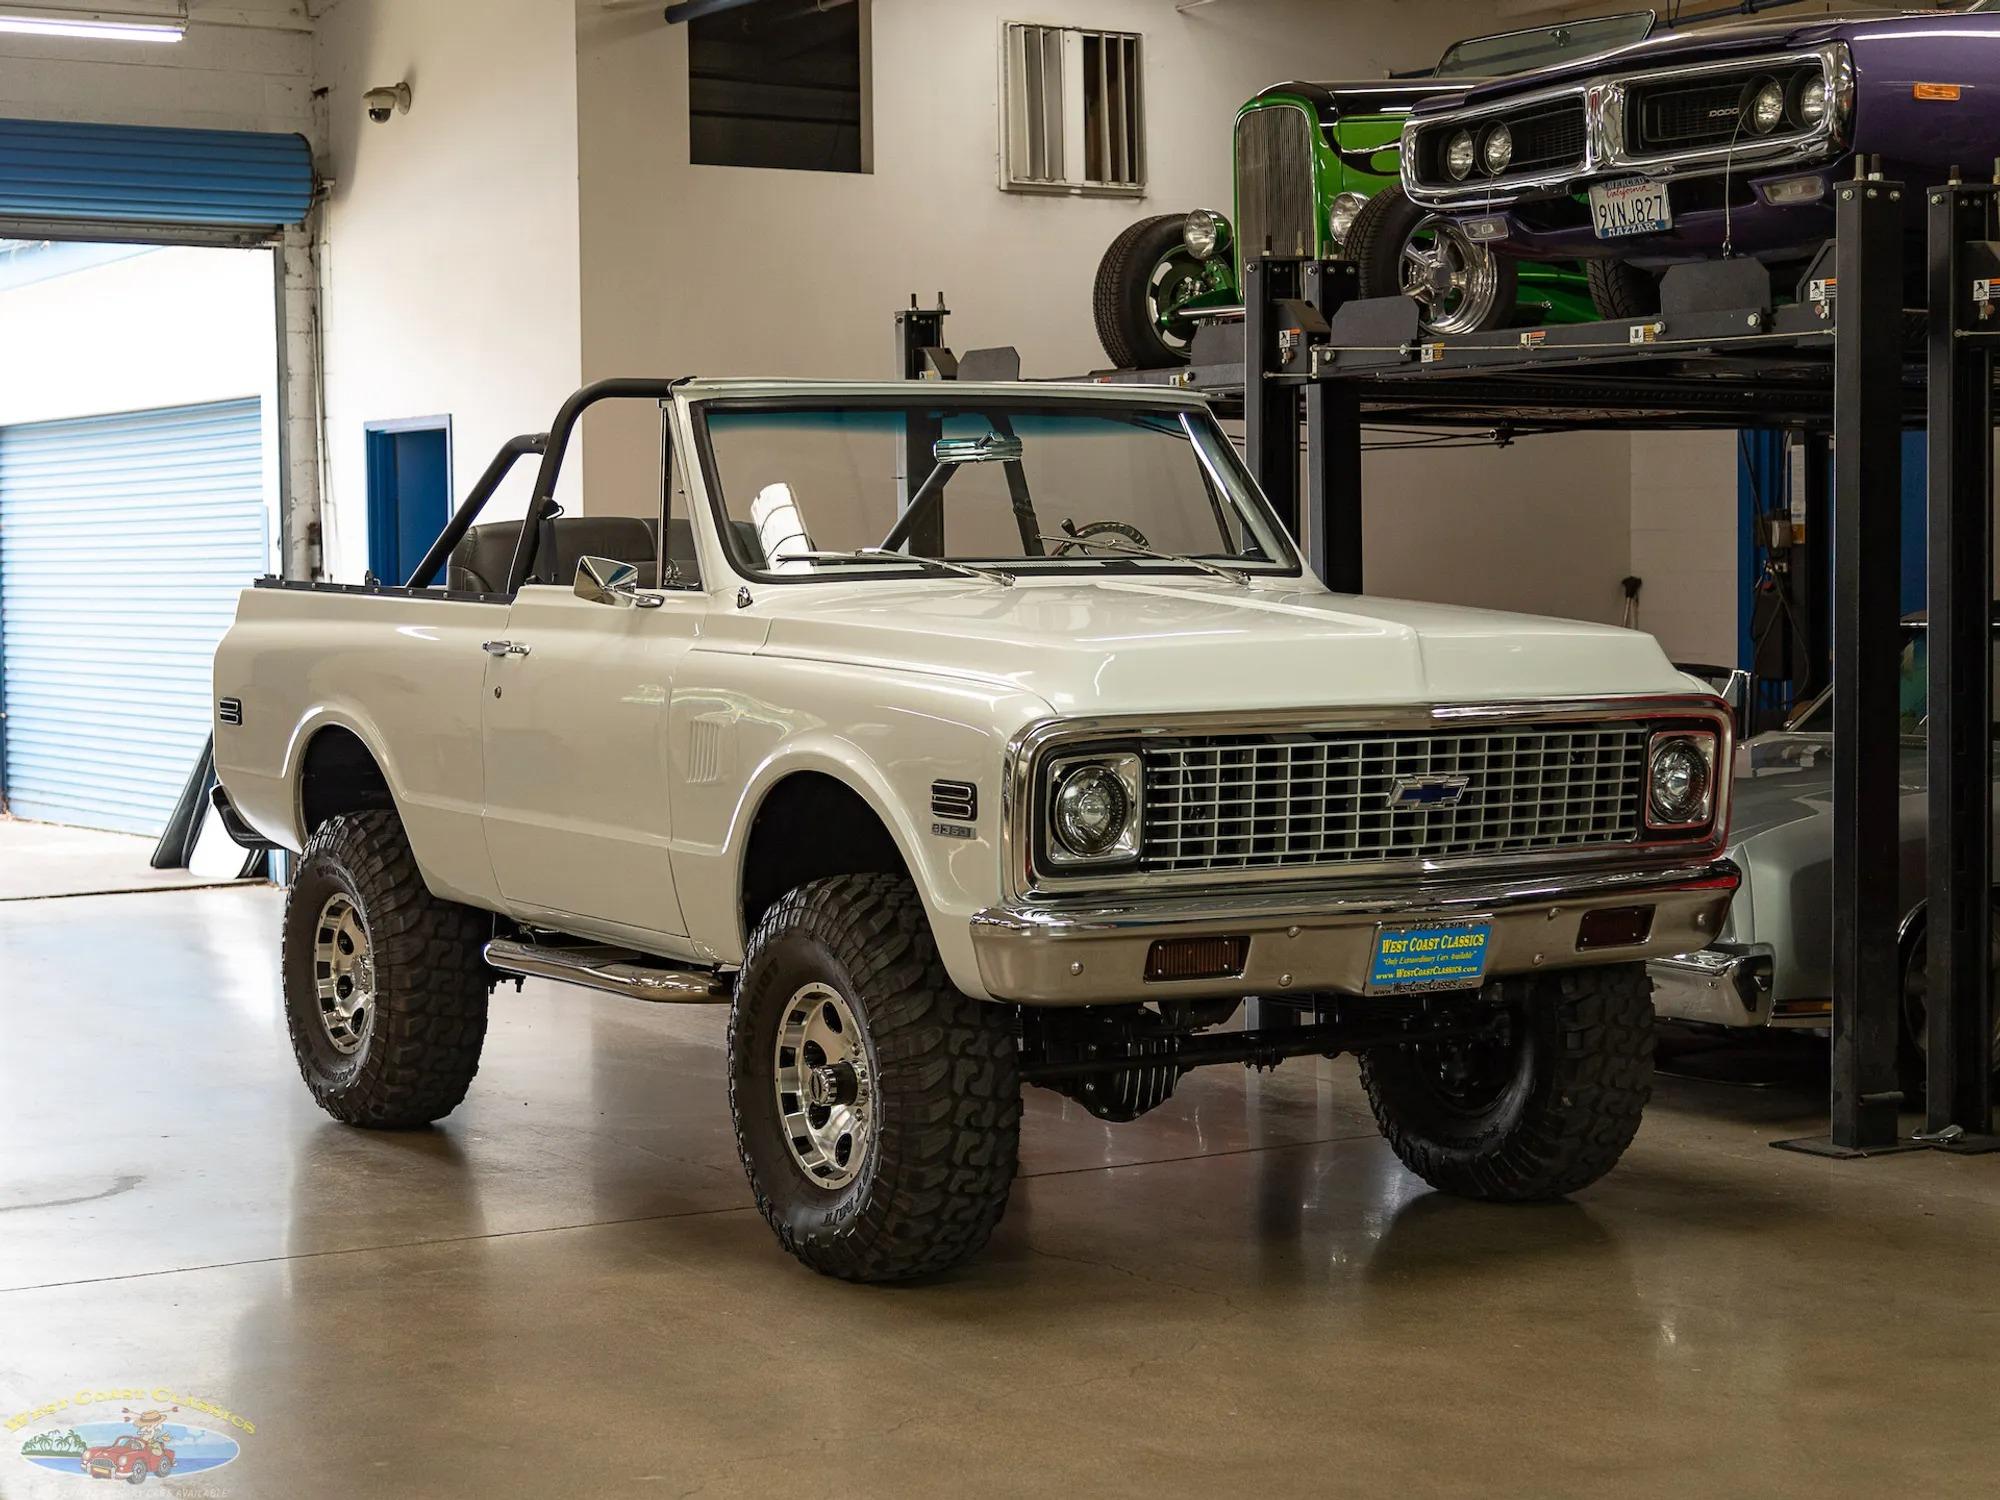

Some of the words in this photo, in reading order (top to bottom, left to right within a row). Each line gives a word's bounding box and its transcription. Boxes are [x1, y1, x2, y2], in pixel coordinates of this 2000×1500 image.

[1709, 107, 1739, 117] DODG
[1607, 176, 1645, 190] MERCED
[1606, 185, 1652, 199] California
[1599, 195, 1662, 229] 9VNJ827
[1382, 939, 1408, 953] WEST
[1409, 936, 1440, 952] COAST
[1440, 933, 1485, 949] CLASSICS
